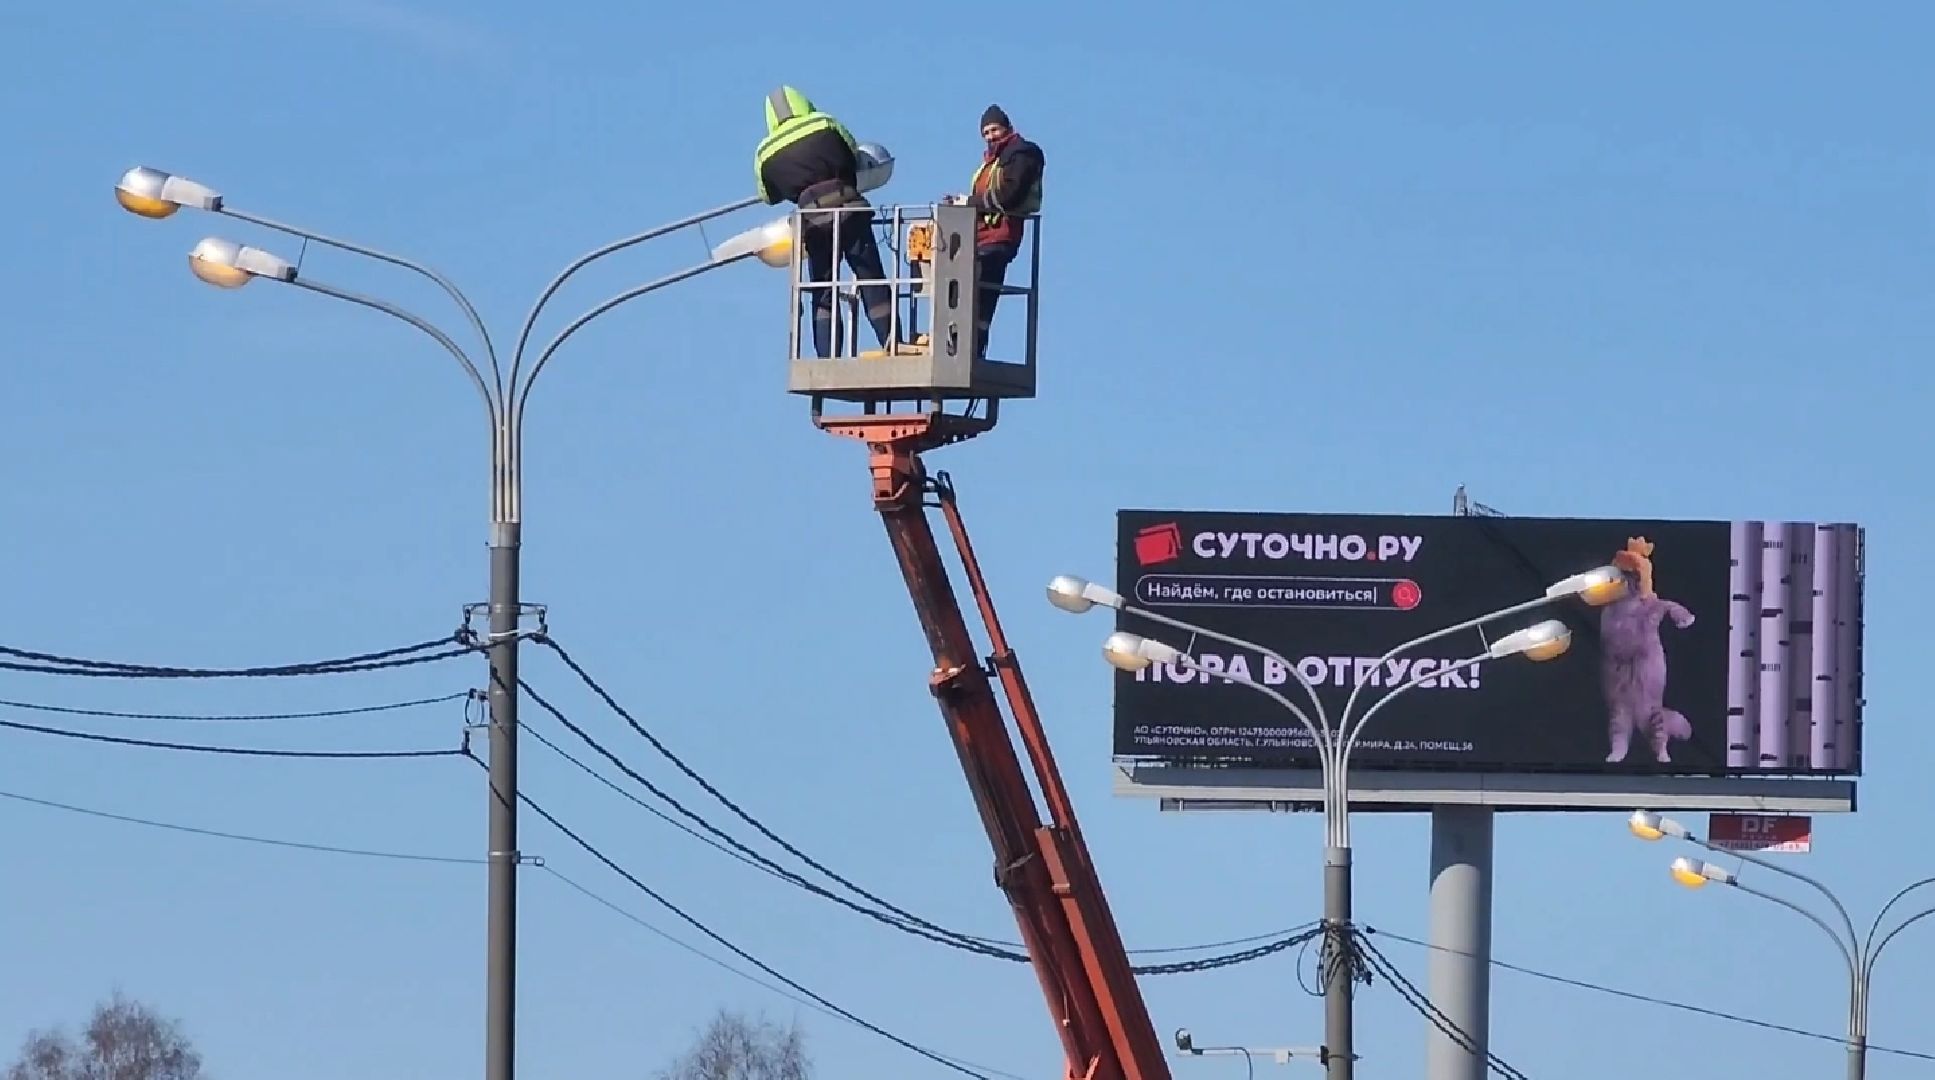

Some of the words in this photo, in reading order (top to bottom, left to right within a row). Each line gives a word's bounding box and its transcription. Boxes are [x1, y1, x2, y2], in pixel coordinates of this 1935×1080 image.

[1192, 531, 1423, 561] СУТОЧНО.РУ
[1147, 582, 1219, 600] Найдём,
[1224, 586, 1252, 601] где
[1264, 655, 1287, 685] В
[1297, 656, 1480, 689] ОТПУСК!
